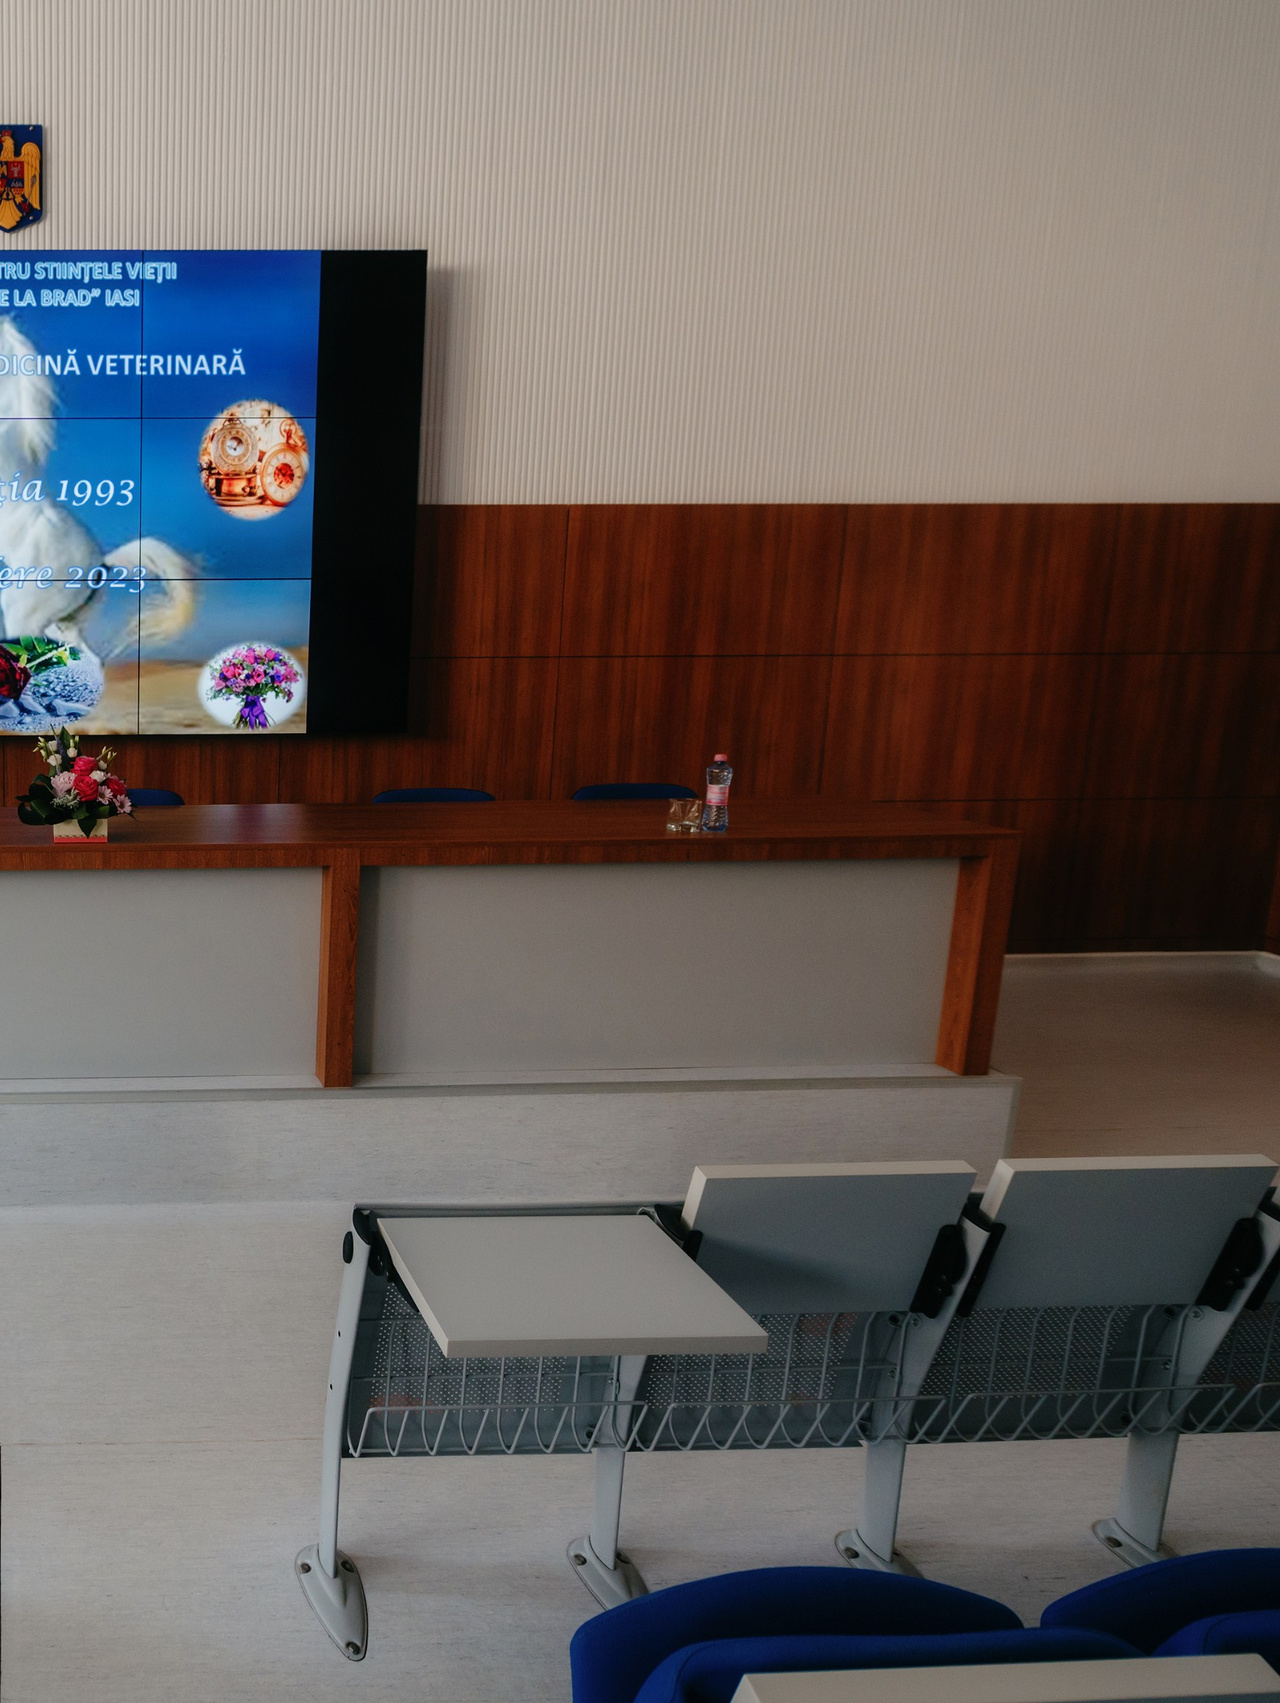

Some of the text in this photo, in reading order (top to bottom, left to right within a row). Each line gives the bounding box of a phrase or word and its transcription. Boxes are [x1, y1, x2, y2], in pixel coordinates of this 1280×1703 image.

[13, 288, 37, 307] LA
[104, 288, 140, 307] IASI
[86, 348, 246, 376] VETERINARĂ
[56, 479, 135, 507] 1993
[65, 566, 148, 593] 2023
